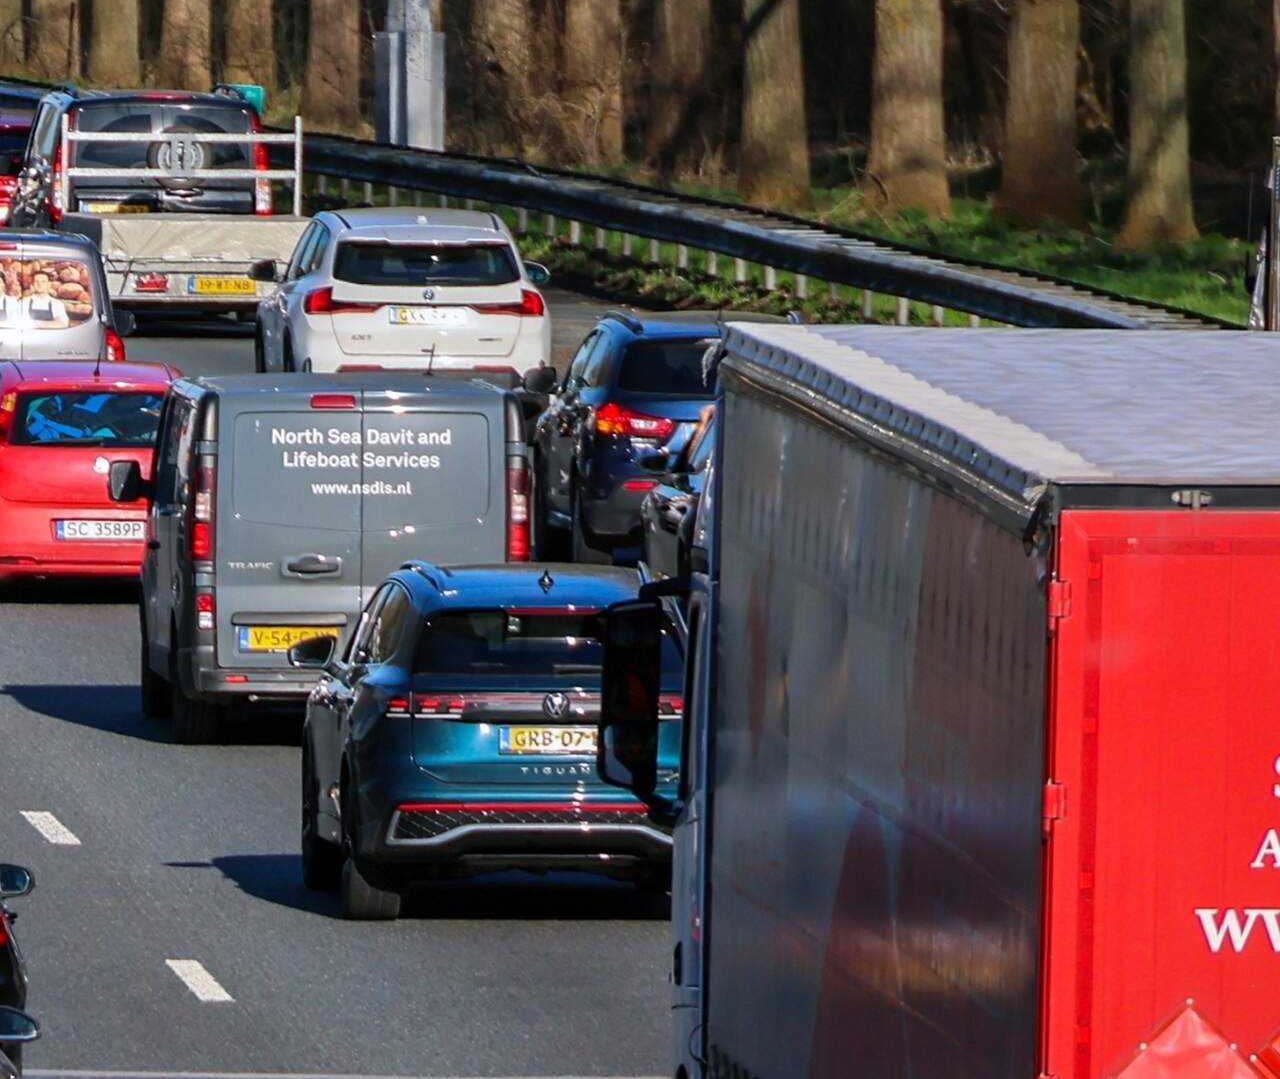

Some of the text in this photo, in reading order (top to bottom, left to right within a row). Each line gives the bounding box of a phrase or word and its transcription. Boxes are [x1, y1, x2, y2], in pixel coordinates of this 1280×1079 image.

[271, 427, 452, 445] North Sea Davit and
[282, 451, 441, 468] Lifeboat Services
[311, 481, 413, 495] www.nsdls.nl
[66, 522, 142, 537] SC 3589P
[227, 561, 274, 570] TRAFIC
[520, 766, 593, 775] TIGUAN
